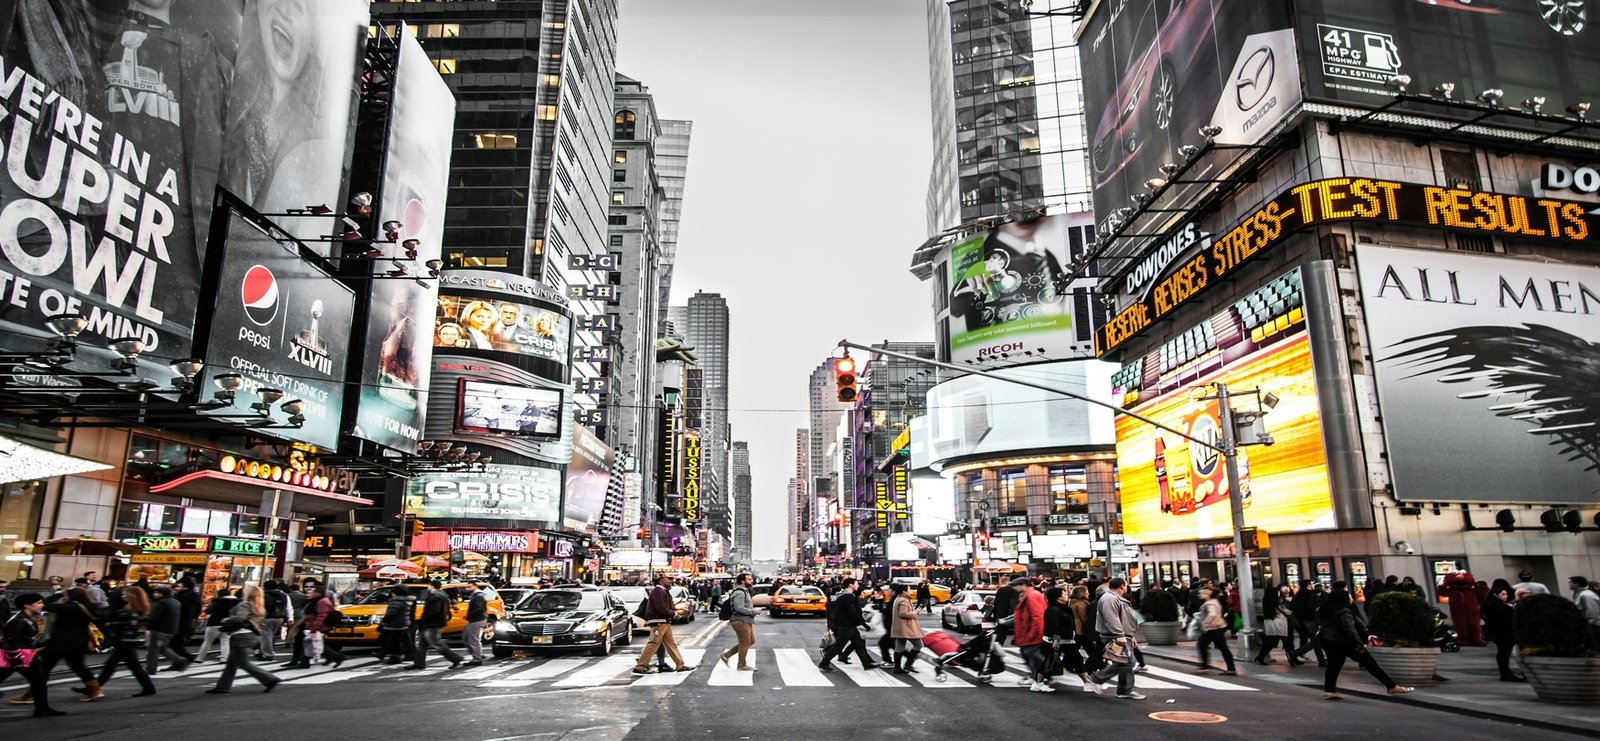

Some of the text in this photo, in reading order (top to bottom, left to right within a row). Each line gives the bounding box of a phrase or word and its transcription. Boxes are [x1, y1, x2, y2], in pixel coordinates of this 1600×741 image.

[1093, 22, 1108, 53] THE
[1323, 29, 1352, 49] 41
[1326, 46, 1362, 60] MPG
[1327, 55, 1362, 66] HIGHWAY
[1329, 66, 1347, 75] EPA
[134, 82, 158, 91] BOWL
[1242, 95, 1277, 134] mazda
[110, 132, 151, 185] IN
[156, 168, 179, 206] A
[1546, 163, 1600, 193] DO
[0, 103, 175, 265] UPER
[1105, 304, 1151, 350] RESERVE
[1154, 256, 1207, 318] REVISES
[1425, 186, 1589, 241] RESULTS
[1377, 263, 1477, 306] ALL
[87, 306, 159, 352] MIND
[239, 326, 271, 350] pepsi
[592, 256, 612, 423] CHAMPS
[514, 333, 565, 353] CRISIS
[978, 341, 1023, 357] RICOH
[287, 341, 333, 376] XLVIII
[438, 363, 488, 371] SHARP
[231, 356, 270, 383] OFFICIAL
[272, 370, 293, 390] SOFT
[294, 379, 322, 399] DRINK
[322, 387, 329, 402] OF
[384, 417, 400, 434] FOR
[400, 422, 420, 441] NOW
[481, 471, 497, 479] the
[500, 473, 520, 481] ones
[503, 467, 519, 476] you
[426, 480, 551, 504] CRISIS
[895, 466, 907, 519] NW VICTORY
[451, 506, 500, 515] SUNDAYS
[230, 541, 260, 552] RICE
[449, 533, 529, 550] CHAMPS
